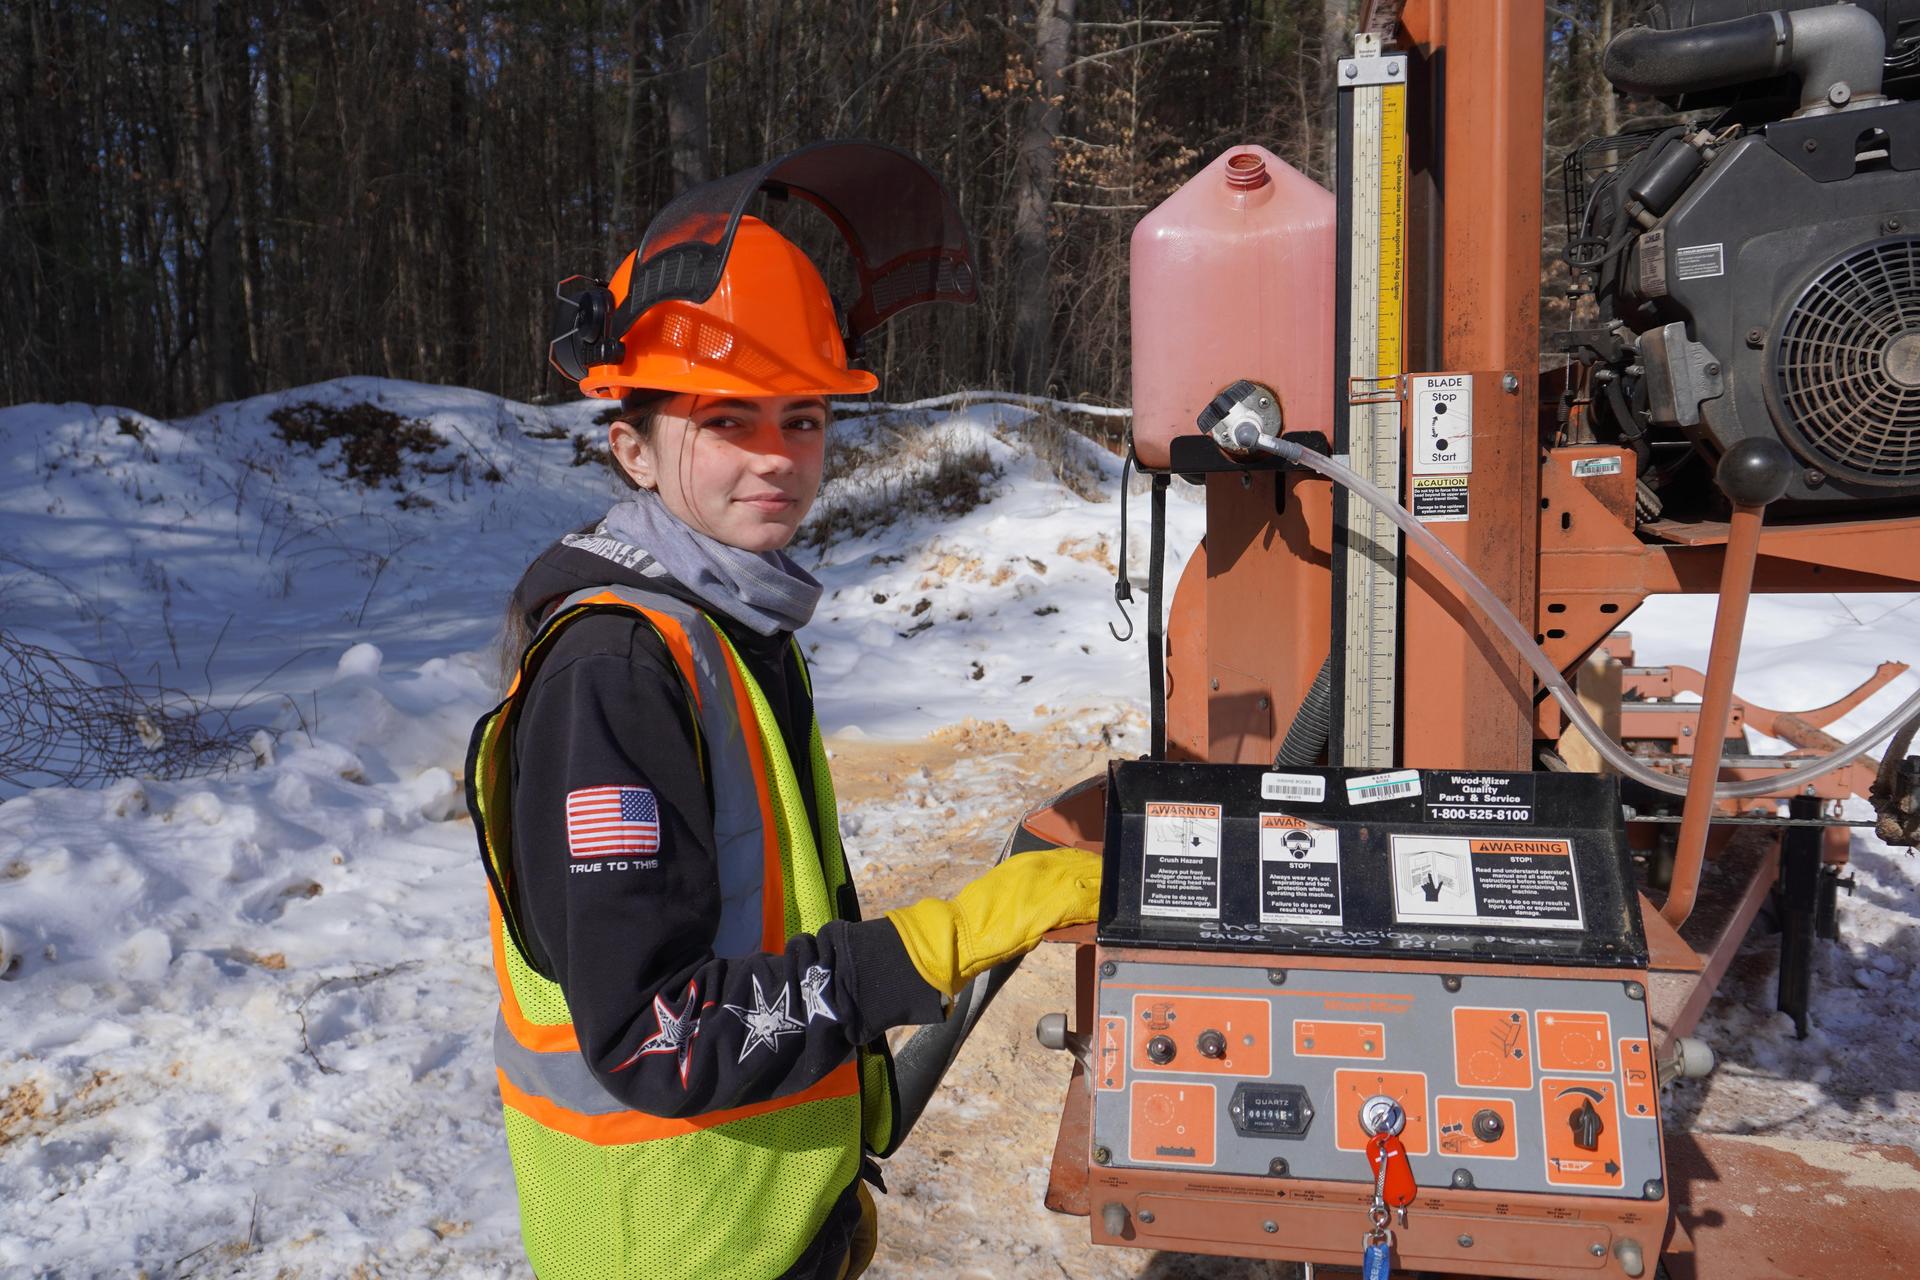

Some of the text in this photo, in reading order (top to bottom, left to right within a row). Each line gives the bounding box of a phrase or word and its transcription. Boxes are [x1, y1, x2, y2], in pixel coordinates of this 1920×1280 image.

[1427, 378, 1462, 388] BLADE
[1432, 392, 1457, 402] Stop
[1432, 453, 1457, 462] Start
[1451, 776, 1510, 785] Wood-Mizer
[1462, 785, 1498, 795] Quality
[1439, 793, 1521, 803] Parts & Service
[1159, 805, 1216, 817] WARNING
[1431, 808, 1529, 821] 1-800-525-8100
[1489, 842, 1562, 853] WARNING
[569, 860, 659, 874] TRUE TO THIS
[1437, 934, 1470, 942] on
